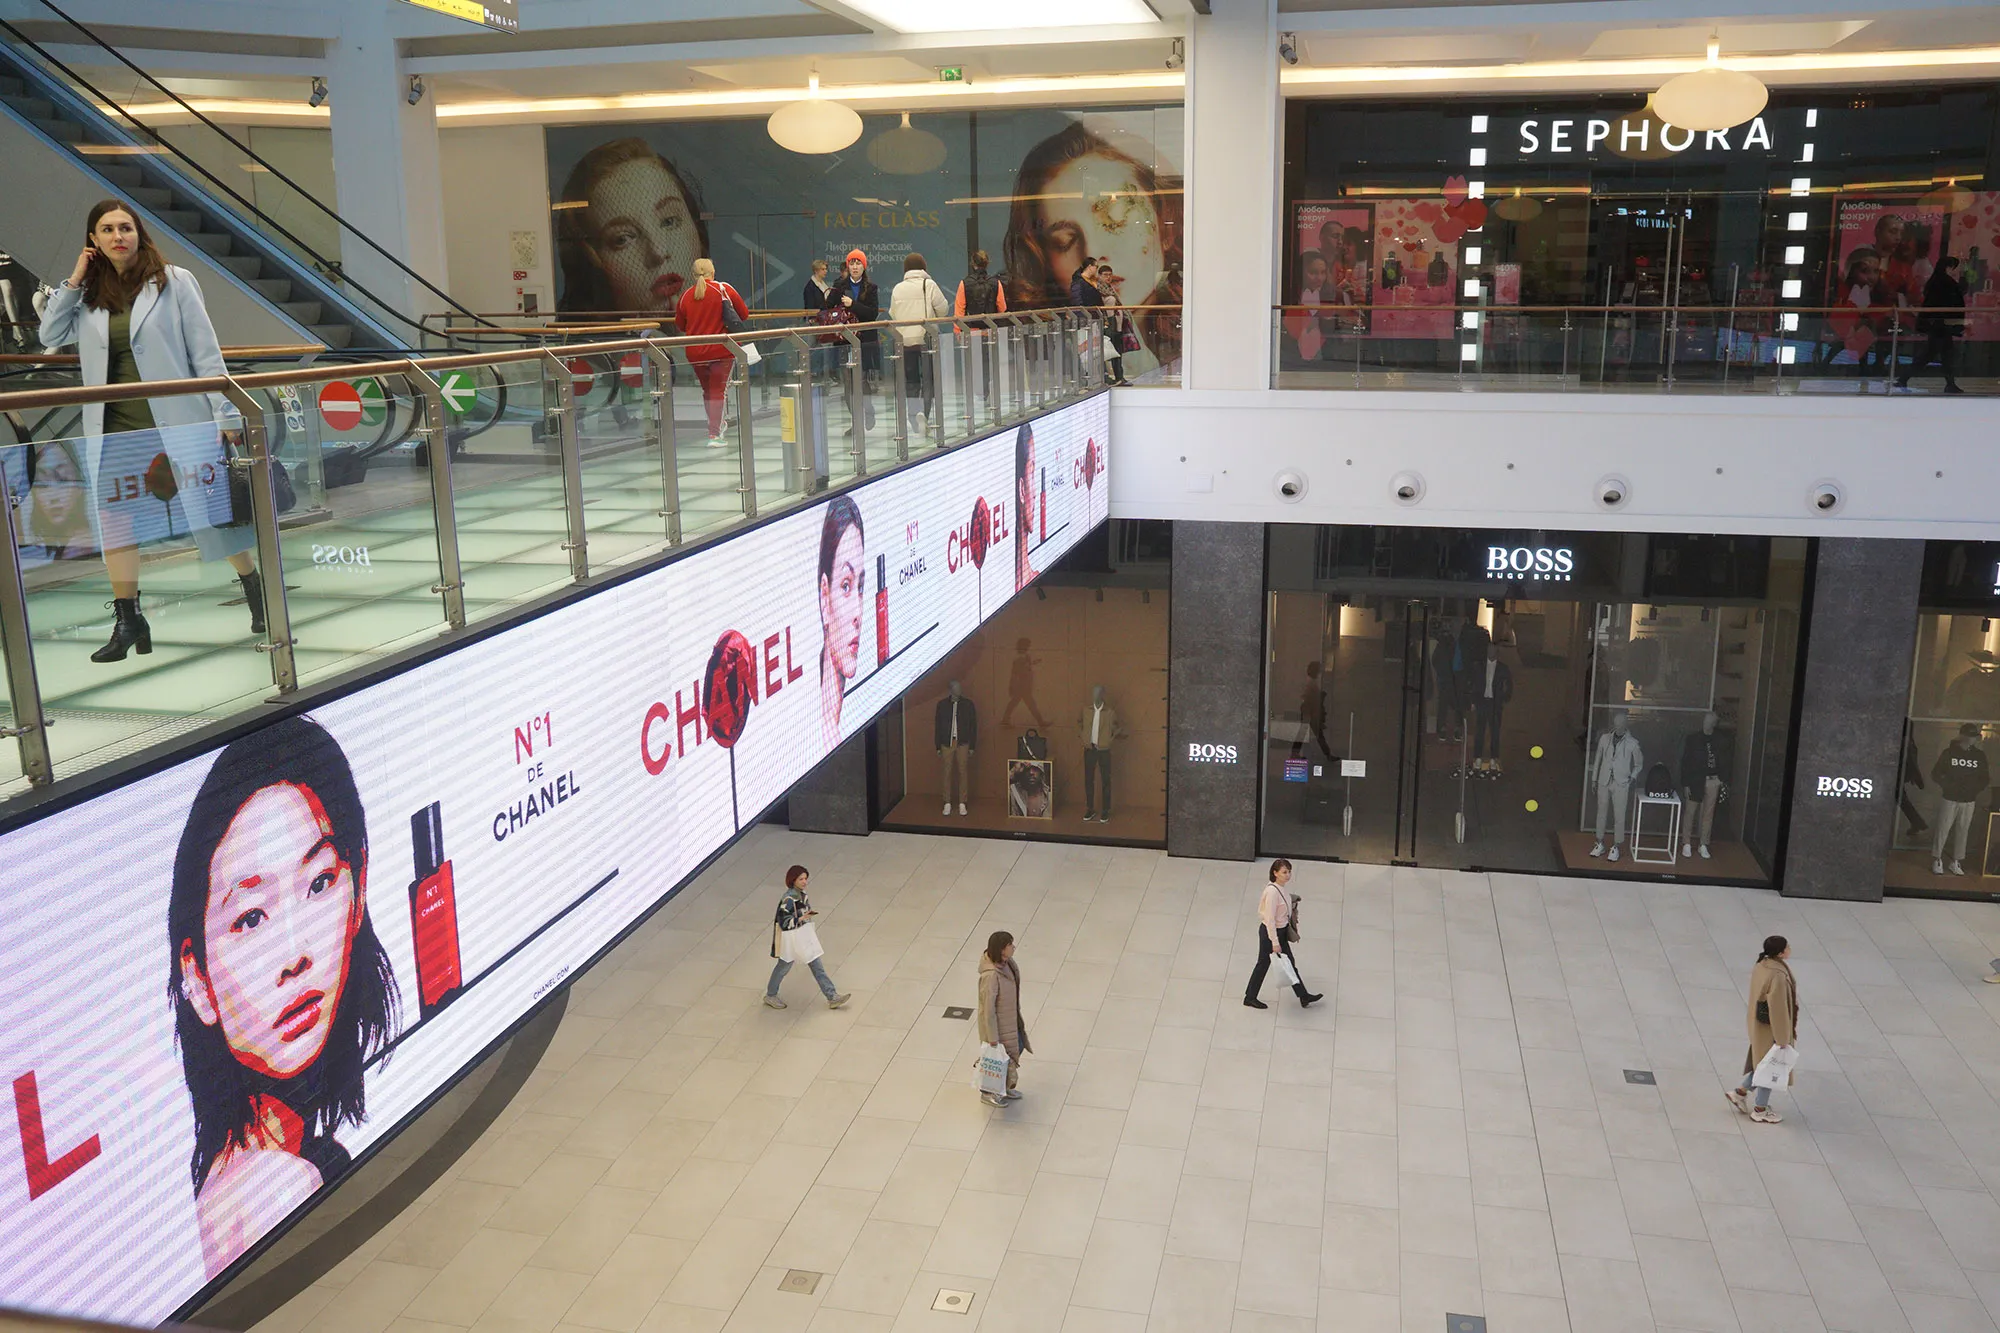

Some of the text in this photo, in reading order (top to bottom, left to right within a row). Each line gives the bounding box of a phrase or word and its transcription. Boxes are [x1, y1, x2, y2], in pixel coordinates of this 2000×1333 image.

[1519, 117, 1771, 153] SEPHORA
[1841, 202, 1882, 210] Любовь
[824, 211, 940, 229] FACE CLASS
[1840, 213, 1876, 221] вокруг
[872, 243, 913, 251] массаж
[866, 252, 906, 264] ффекто
[1074, 443, 1105, 490] CHEL
[1486, 547, 1573, 573] BOSS
[899, 556, 927, 585] CHANEL
[1486, 572, 1571, 581] HUGO BOSS
[1189, 743, 1238, 759] BOSS
[1951, 758, 1978, 768] BOSS
[528, 762, 544, 783] DE
[1817, 776, 1873, 793] BOSS
[493, 770, 580, 842] CHANEL
[421, 898, 445, 917] CHANEL
